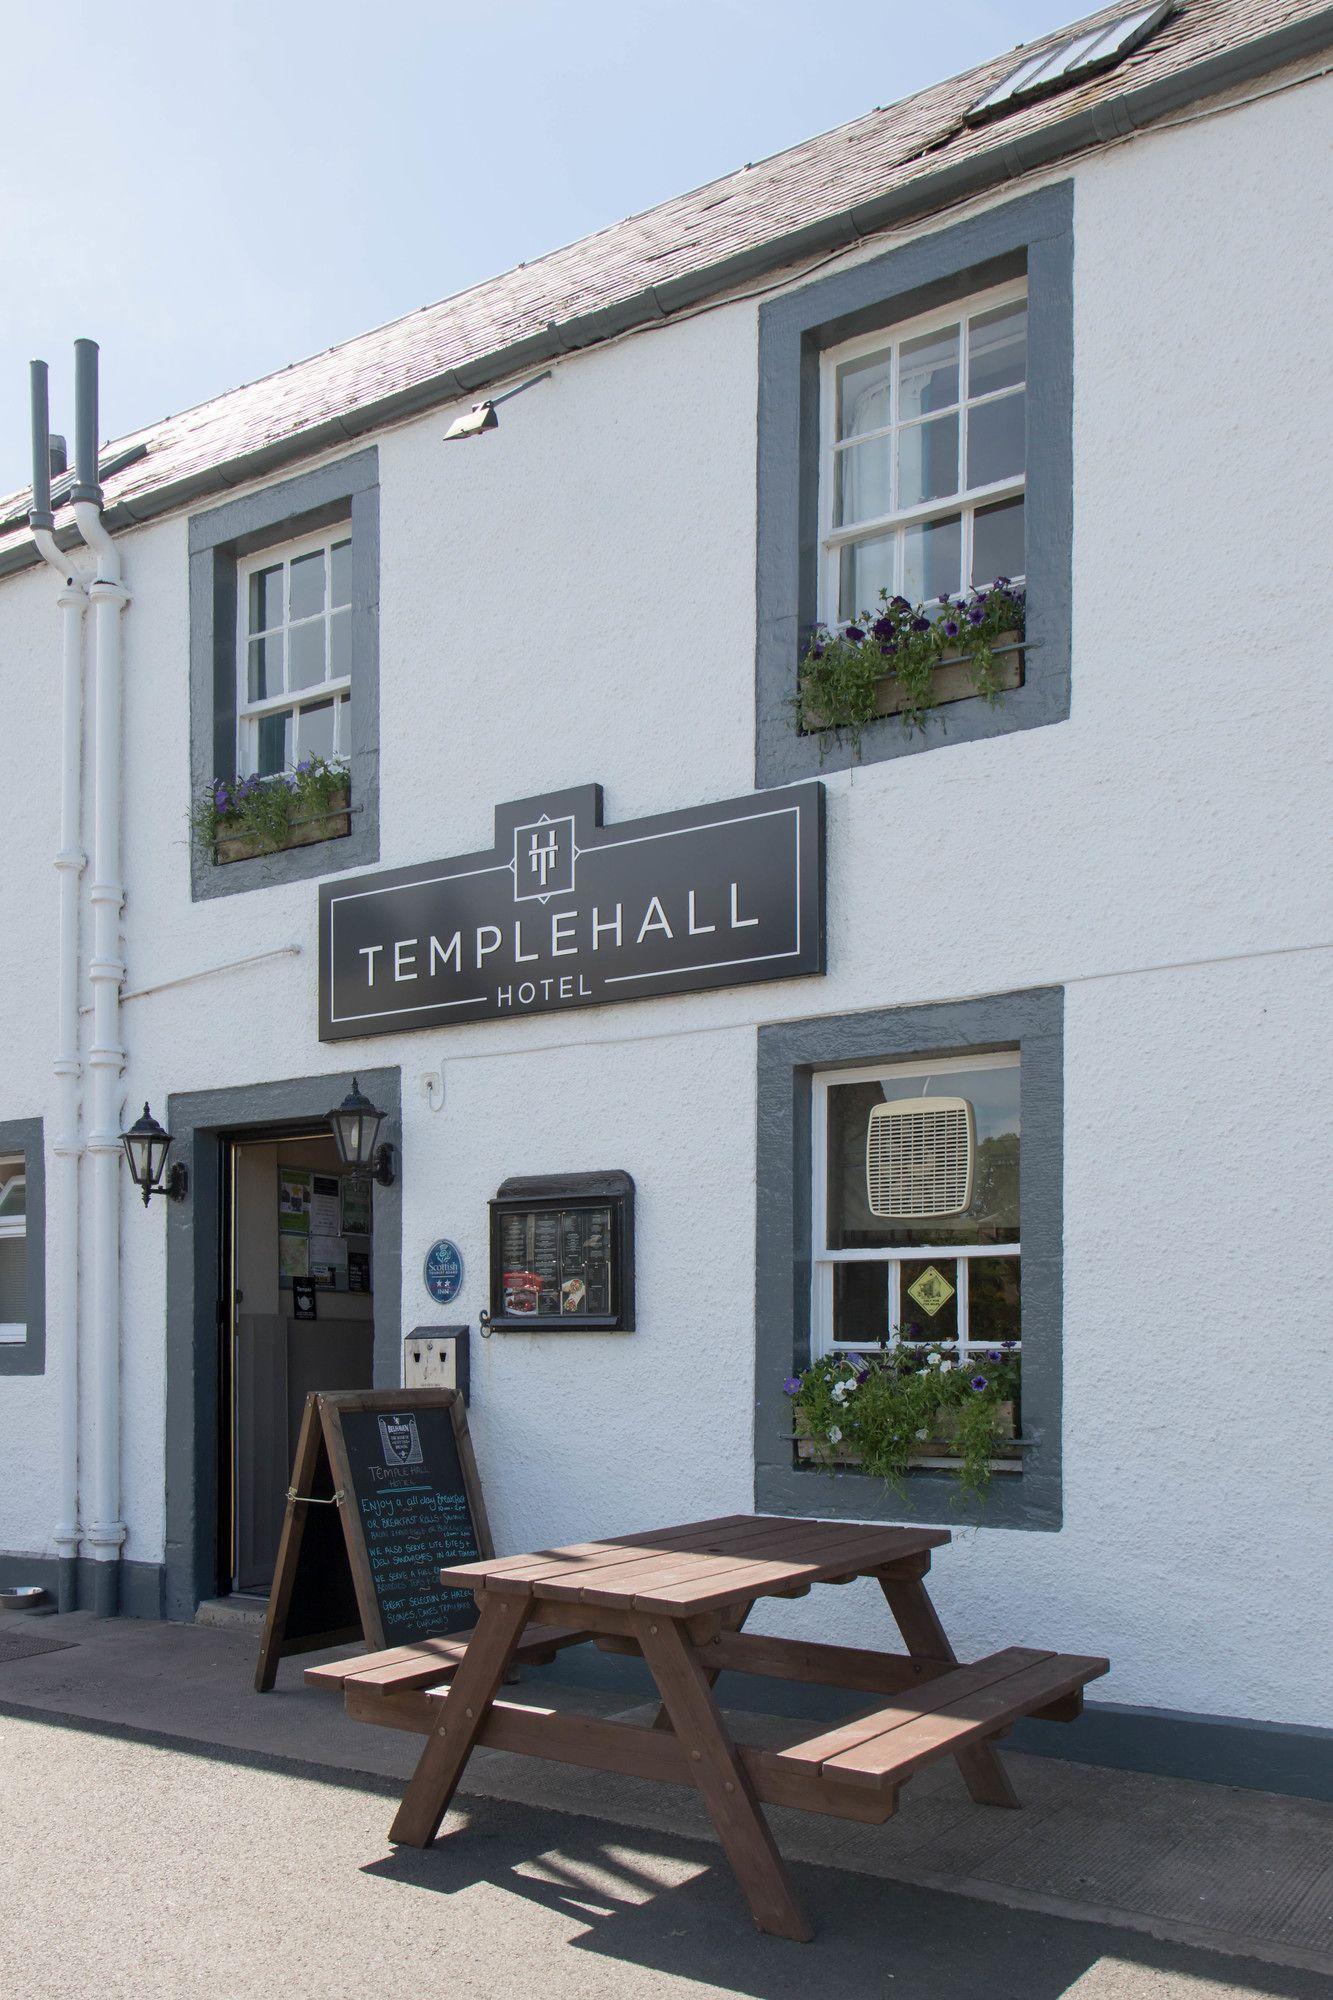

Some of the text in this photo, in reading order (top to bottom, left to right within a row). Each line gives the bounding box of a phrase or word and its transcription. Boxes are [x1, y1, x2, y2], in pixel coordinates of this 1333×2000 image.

[359, 883, 759, 986] TEMPLEHALL
[497, 975, 592, 1007] HOTEL
[428, 1262, 458, 1271] Scottish
